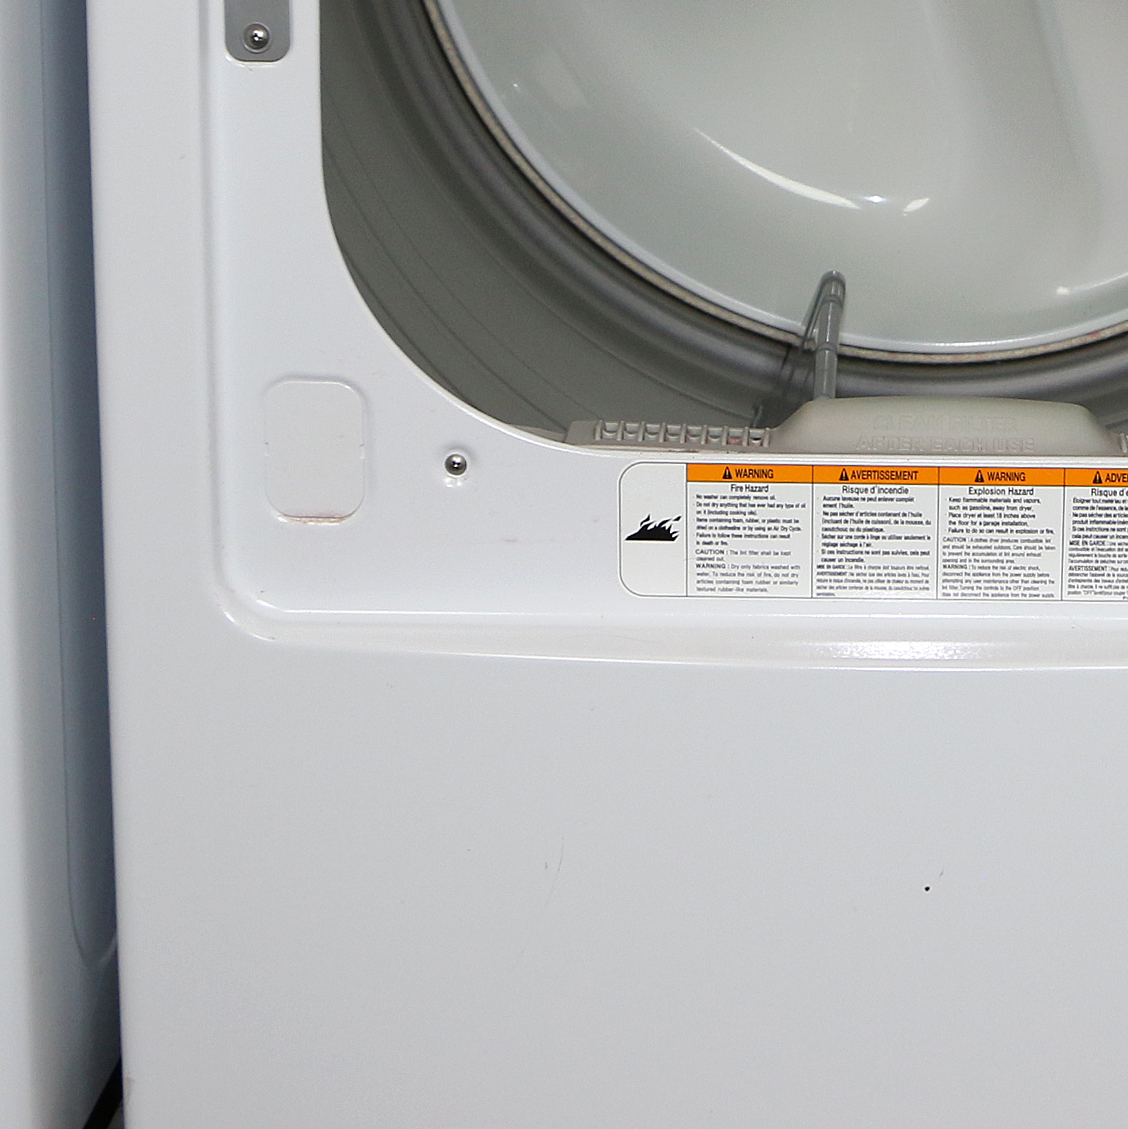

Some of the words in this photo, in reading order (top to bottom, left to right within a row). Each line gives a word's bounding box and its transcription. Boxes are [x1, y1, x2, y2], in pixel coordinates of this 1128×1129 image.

[735, 469, 774, 479] WARNING
[850, 471, 918, 480] AVERTISSEMENT
[987, 472, 1026, 481] WARNING
[842, 484, 869, 495] Risque
[968, 487, 1006, 496] Explosion
[1091, 488, 1118, 497] Risque
